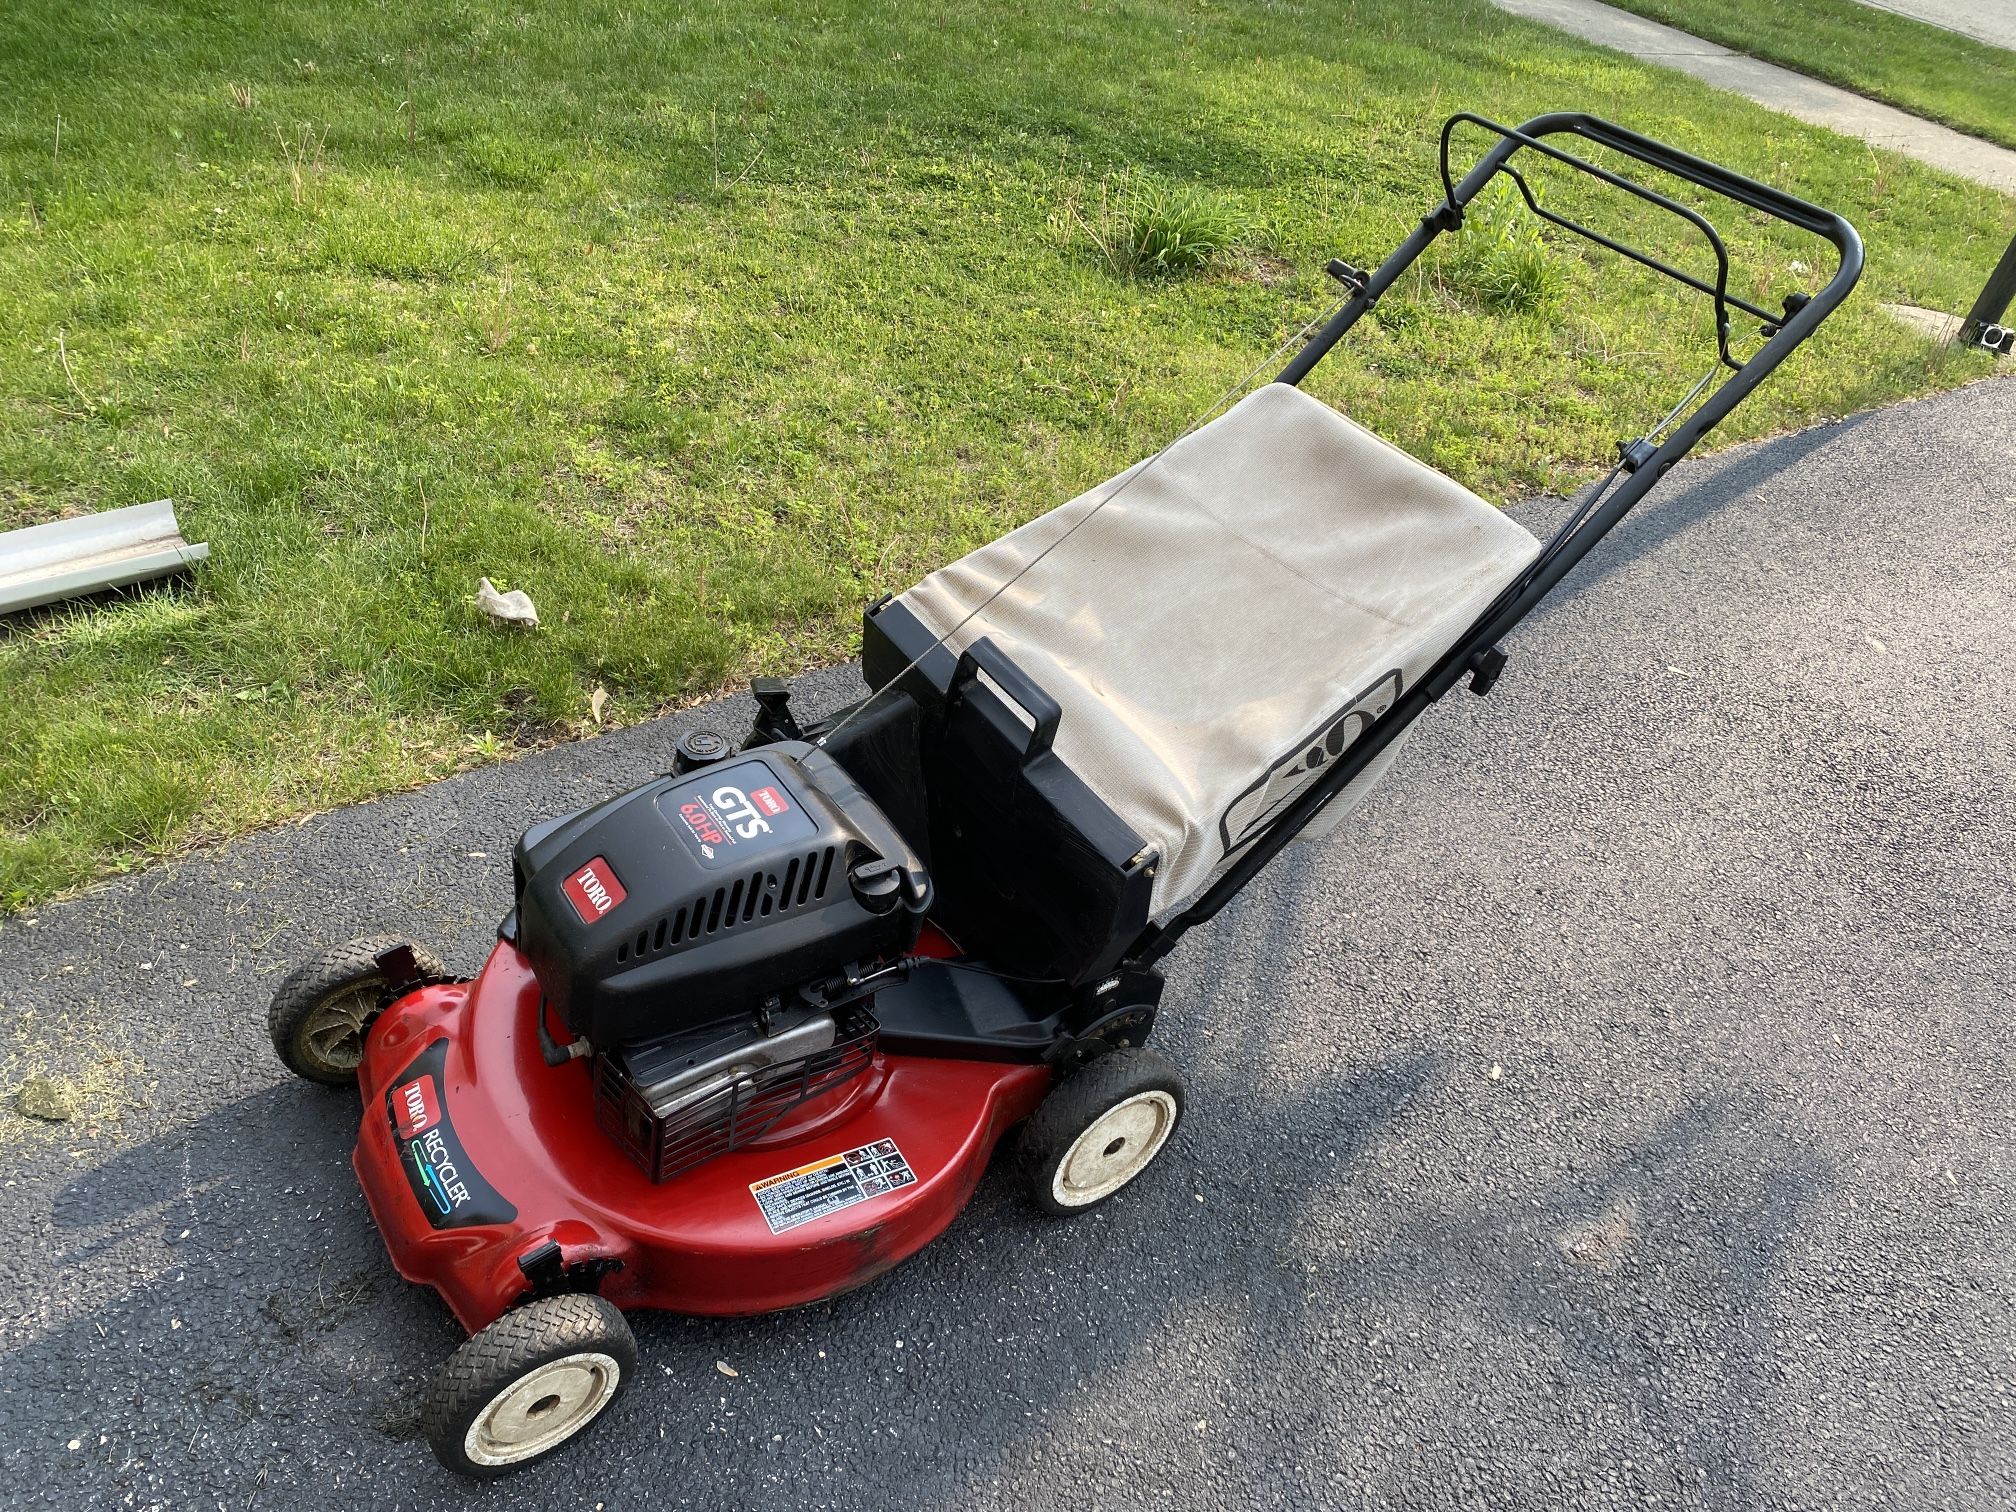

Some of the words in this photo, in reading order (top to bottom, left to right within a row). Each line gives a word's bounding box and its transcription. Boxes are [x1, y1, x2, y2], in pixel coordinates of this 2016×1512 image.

[712, 786, 770, 839] GTS
[758, 789, 781, 814] TORO
[577, 867, 612, 911] TORO
[403, 1081, 428, 1129] TORO
[423, 1128, 469, 1208] RECYCLER
[760, 1171, 800, 1189] WARNING
